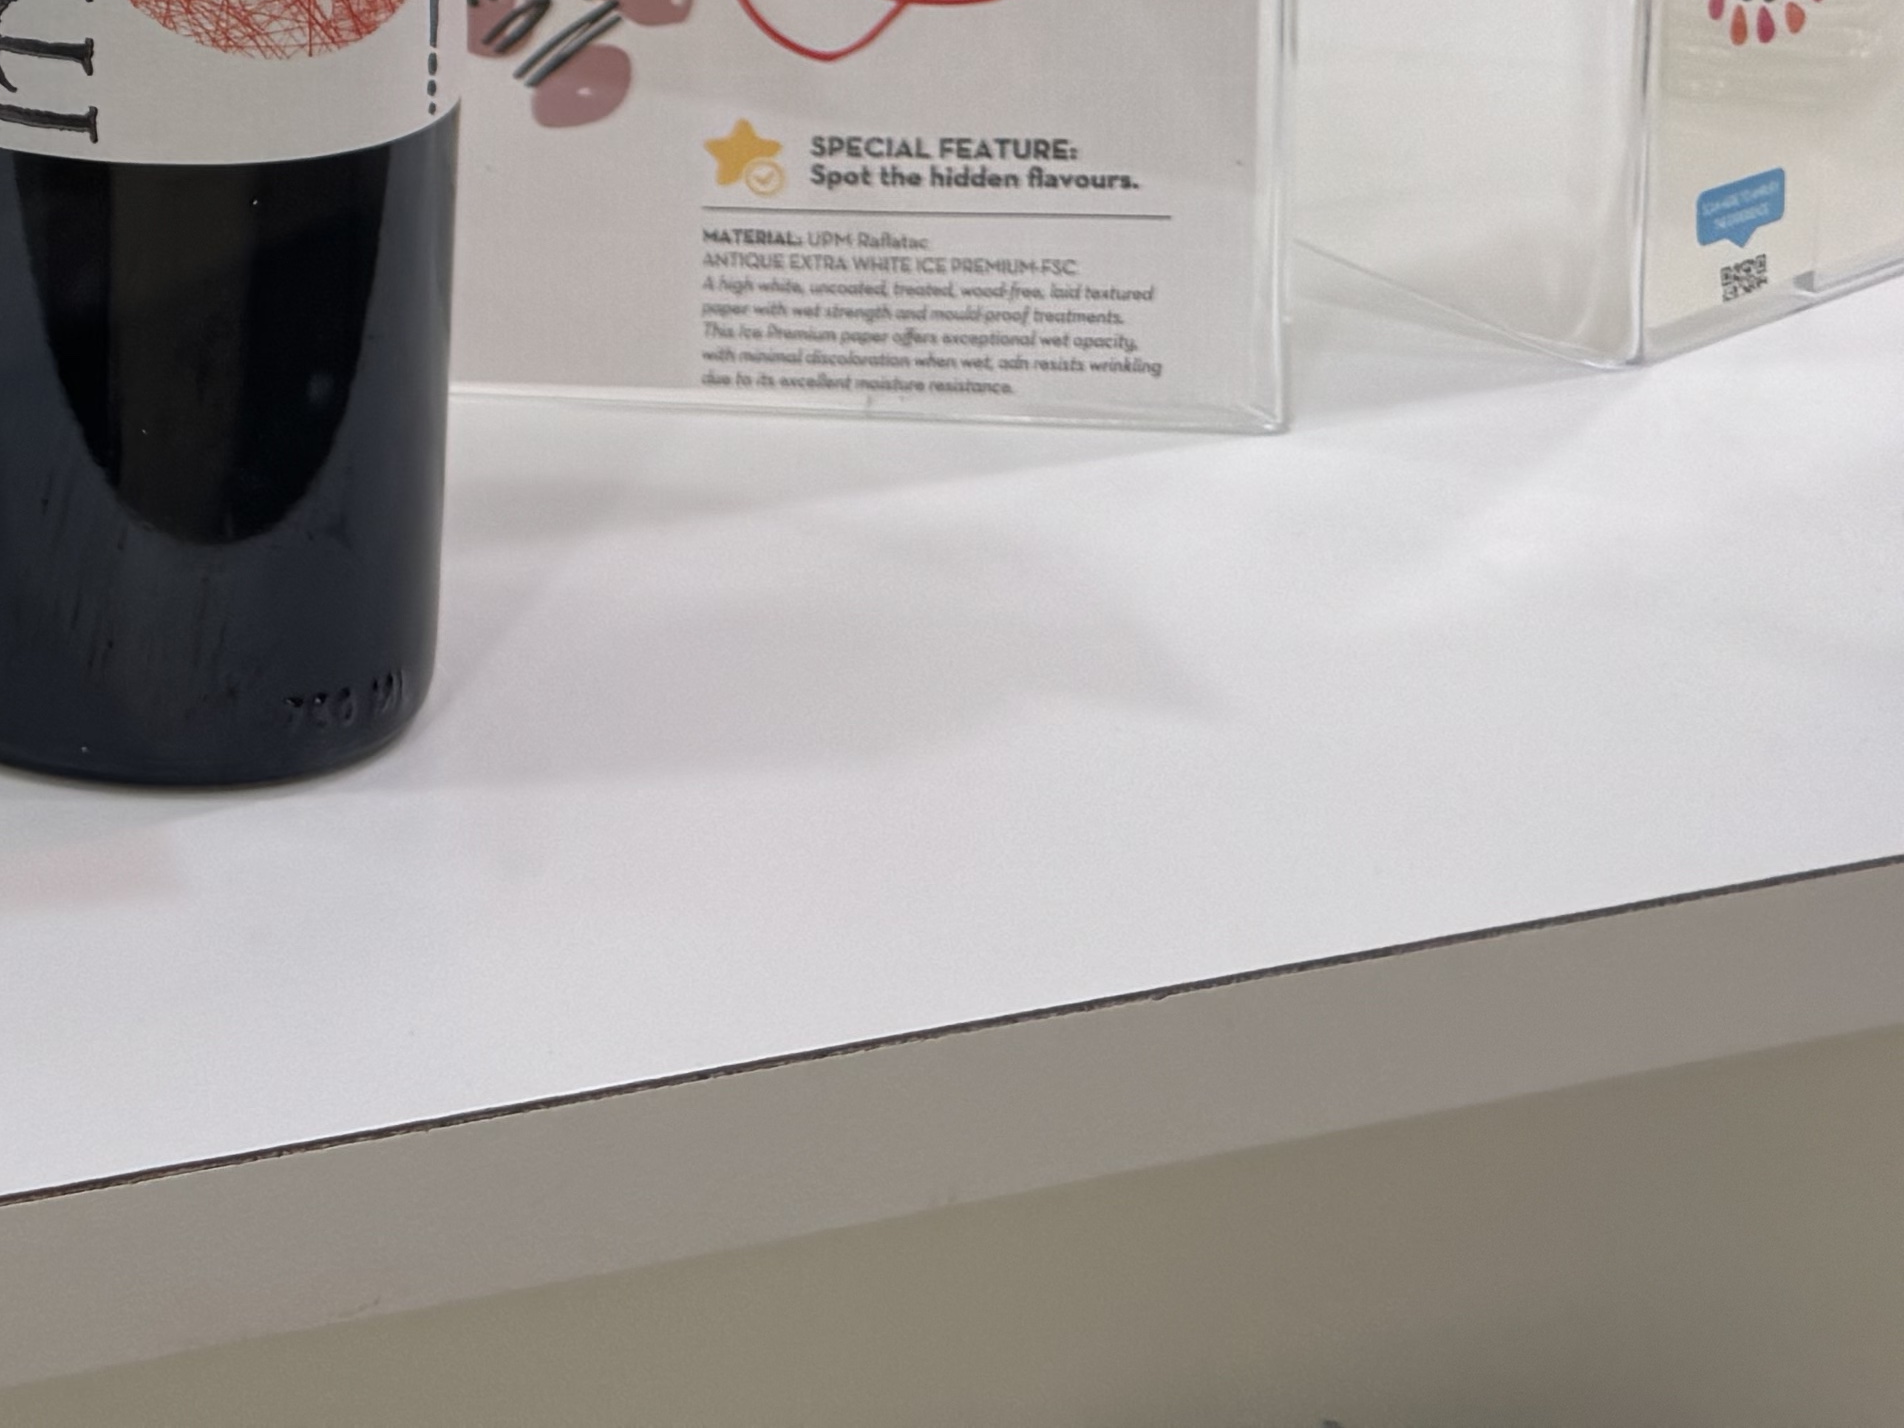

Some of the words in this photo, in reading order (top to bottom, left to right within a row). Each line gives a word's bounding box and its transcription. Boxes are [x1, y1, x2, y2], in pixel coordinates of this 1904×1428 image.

[811, 135, 931, 159] SPECIAL
[939, 137, 1077, 160] FEATURE:
[810, 163, 872, 190] Spot
[879, 164, 923, 187] the
[929, 165, 1020, 188] hidden
[1026, 166, 1139, 190] flavours.
